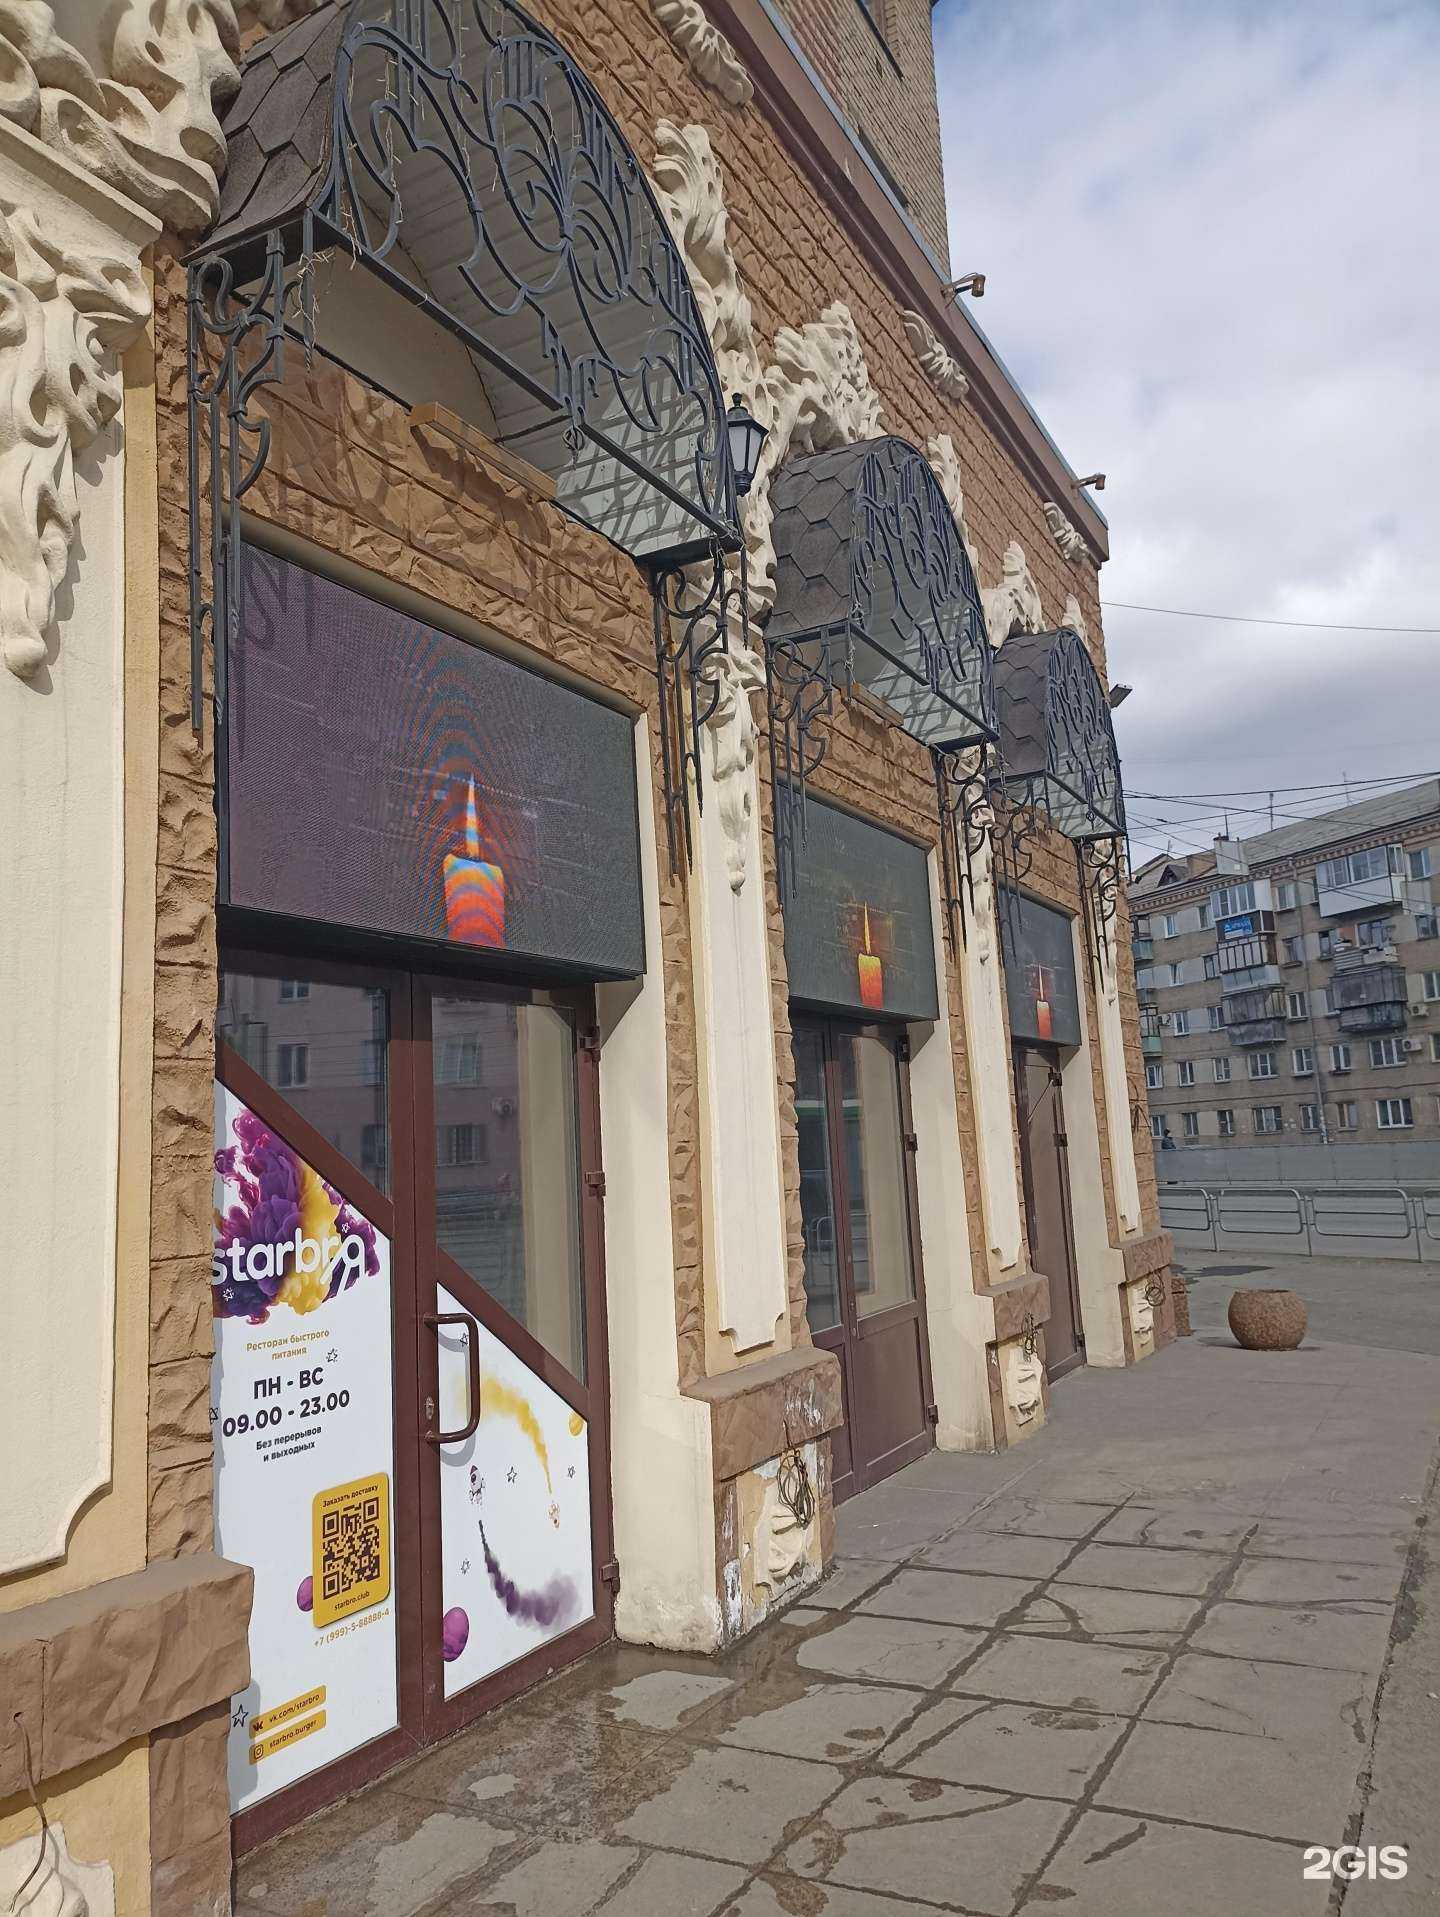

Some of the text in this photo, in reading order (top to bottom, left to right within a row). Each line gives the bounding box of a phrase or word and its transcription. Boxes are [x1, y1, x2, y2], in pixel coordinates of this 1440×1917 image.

[246, 1330, 330, 1351] Ресторан быстрого
[272, 1347, 307, 1360] питания
[254, 1376, 281, 1399] ПН
[299, 1367, 324, 1388] ВС
[222, 1406, 282, 1437] 09.00
[300, 1390, 350, 1418] 23.00
[256, 1426, 322, 1450] Без перерывов
[271, 1441, 315, 1460] выходных
[323, 1494, 350, 1507] Заказать
[270, 1720, 317, 1748] starbro.burger
